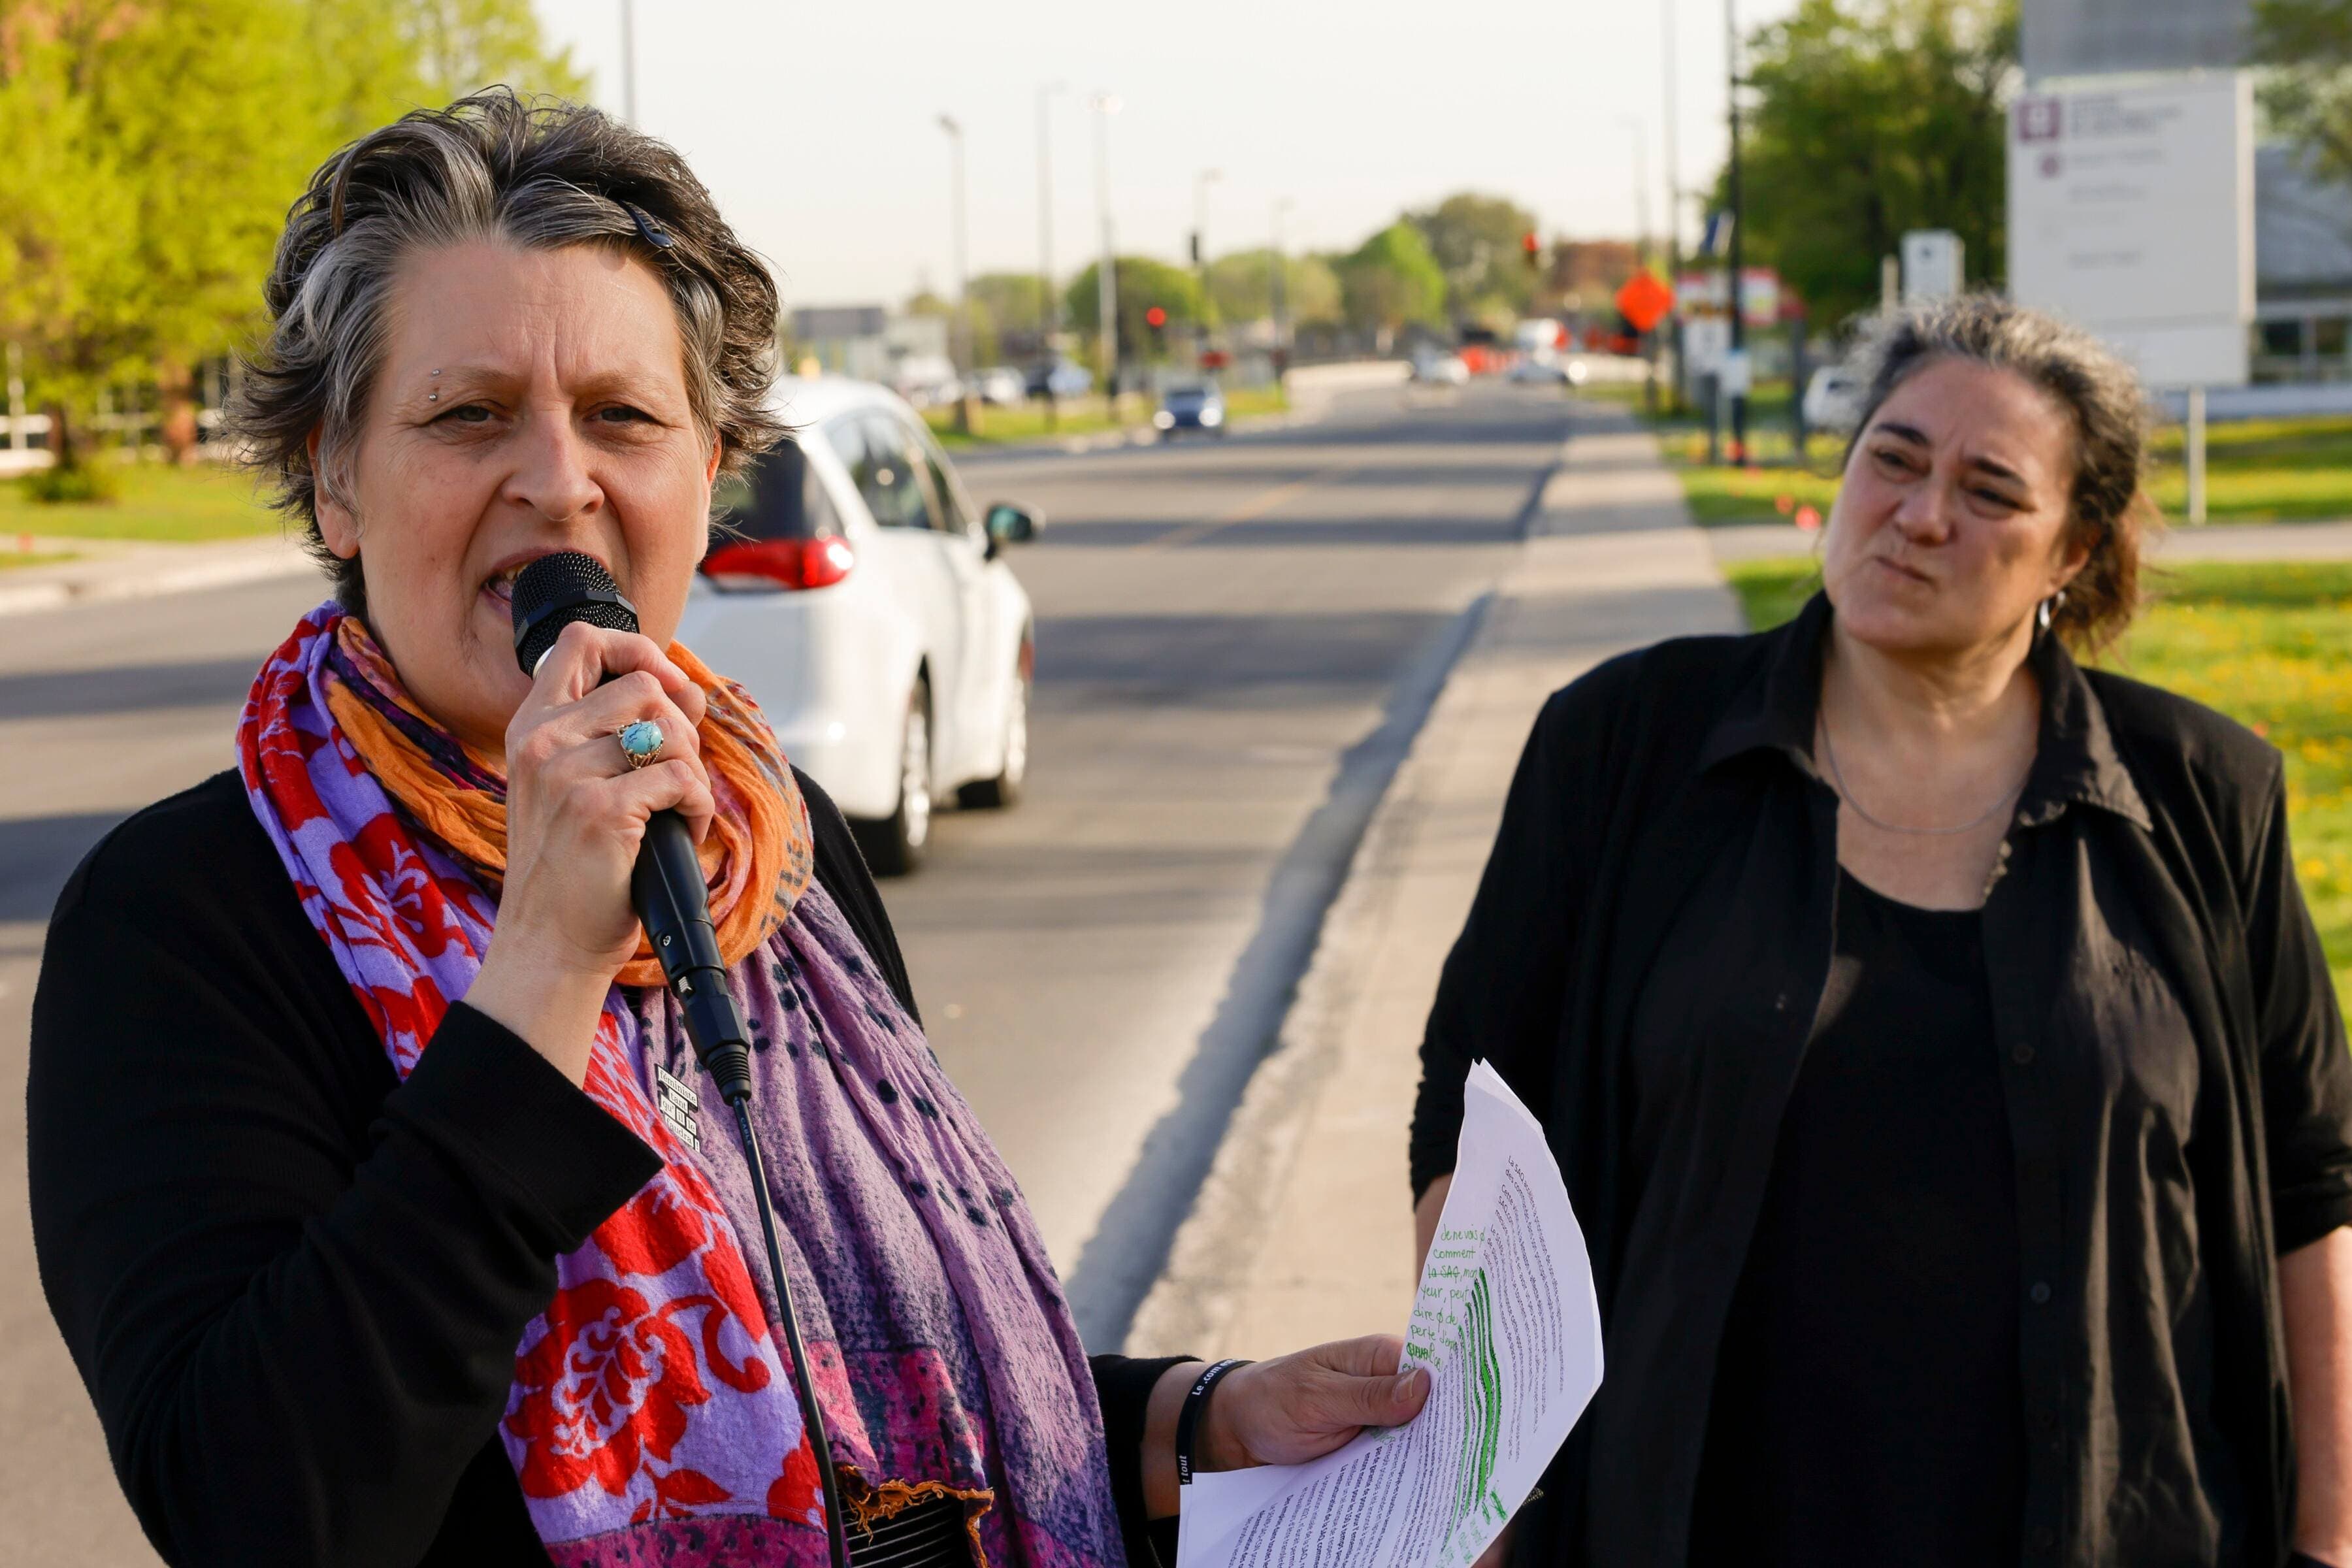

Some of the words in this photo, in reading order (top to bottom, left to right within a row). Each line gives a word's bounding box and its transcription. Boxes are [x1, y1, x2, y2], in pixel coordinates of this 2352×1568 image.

[660, 1070, 696, 1103] féministe
[670, 1091, 687, 1110] tant
[662, 1100, 675, 1112] qu'
[677, 1109, 684, 1124] il
[687, 1119, 696, 1133] le
[666, 1117, 693, 1143] faudra
[1505, 1169, 1514, 1183] des
[1508, 1155, 1514, 1167] La
[1514, 1164, 1524, 1183] SAQ
[1501, 1184, 1513, 1205] Cette
[1490, 1224, 1496, 1236] Le
[1495, 1209, 1508, 1236] mesure
[1486, 1237, 1493, 1249] de
[1411, 1324, 1437, 1341] perte
[1192, 1384, 1205, 1396] Le
[1203, 1366, 1222, 1384] .com
[1179, 1455, 1188, 1476] tout
[1339, 1463, 1348, 1473] La
[1337, 1527, 1347, 1550] temps
